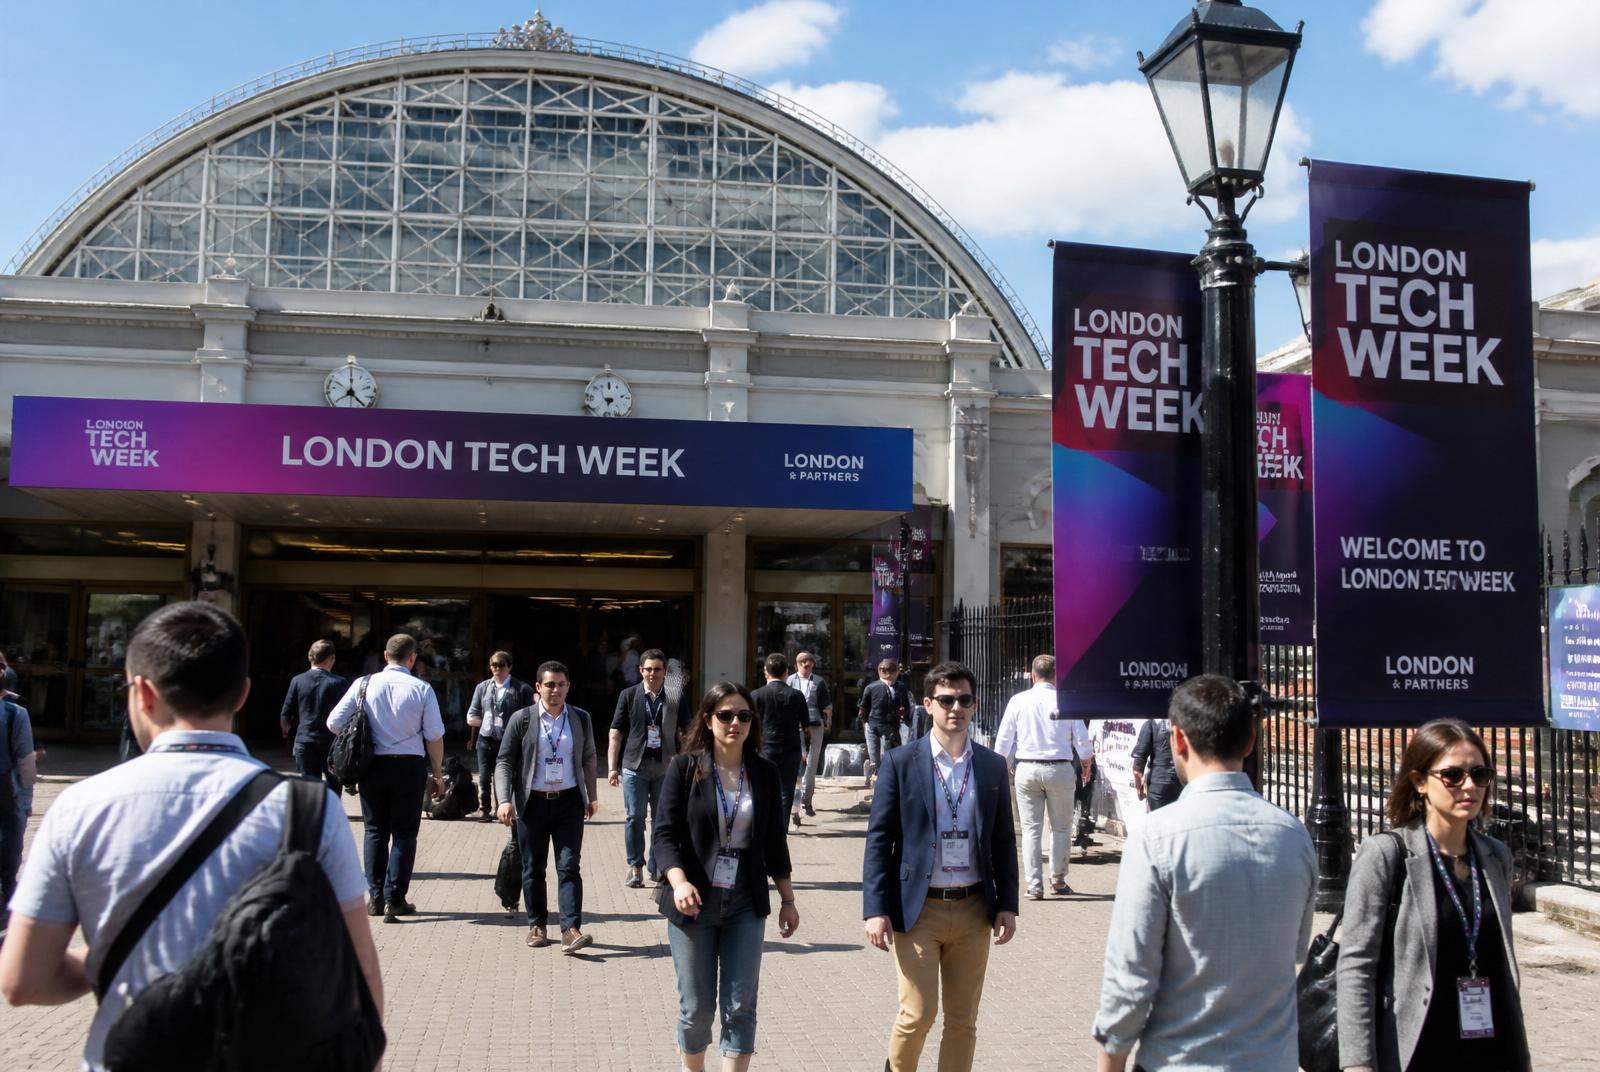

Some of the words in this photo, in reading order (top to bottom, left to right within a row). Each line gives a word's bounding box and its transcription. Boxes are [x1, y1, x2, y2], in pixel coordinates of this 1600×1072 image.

[1335, 239, 1467, 277] LONDON
[1335, 273, 1475, 330] TECH
[1074, 308, 1183, 339] LONDON
[1073, 336, 1188, 386] TECH
[1337, 327, 1504, 386] WEEK
[1074, 384, 1205, 434] WEEK
[85, 429, 147, 449] TECH
[90, 448, 160, 467] WEEK
[282, 435, 453, 470] LONDON
[464, 441, 566, 474] TECH
[577, 445, 685, 478] WEEK
[784, 453, 864, 470] LONDON
[800, 471, 860, 482] PARTNERS
[1340, 536, 1452, 561] WELCOME
[1456, 539, 1486, 562] TO
[1341, 568, 1420, 590] LONDON
[1385, 656, 1474, 675] LONDON
[1404, 678, 1469, 690] PARTNERS
